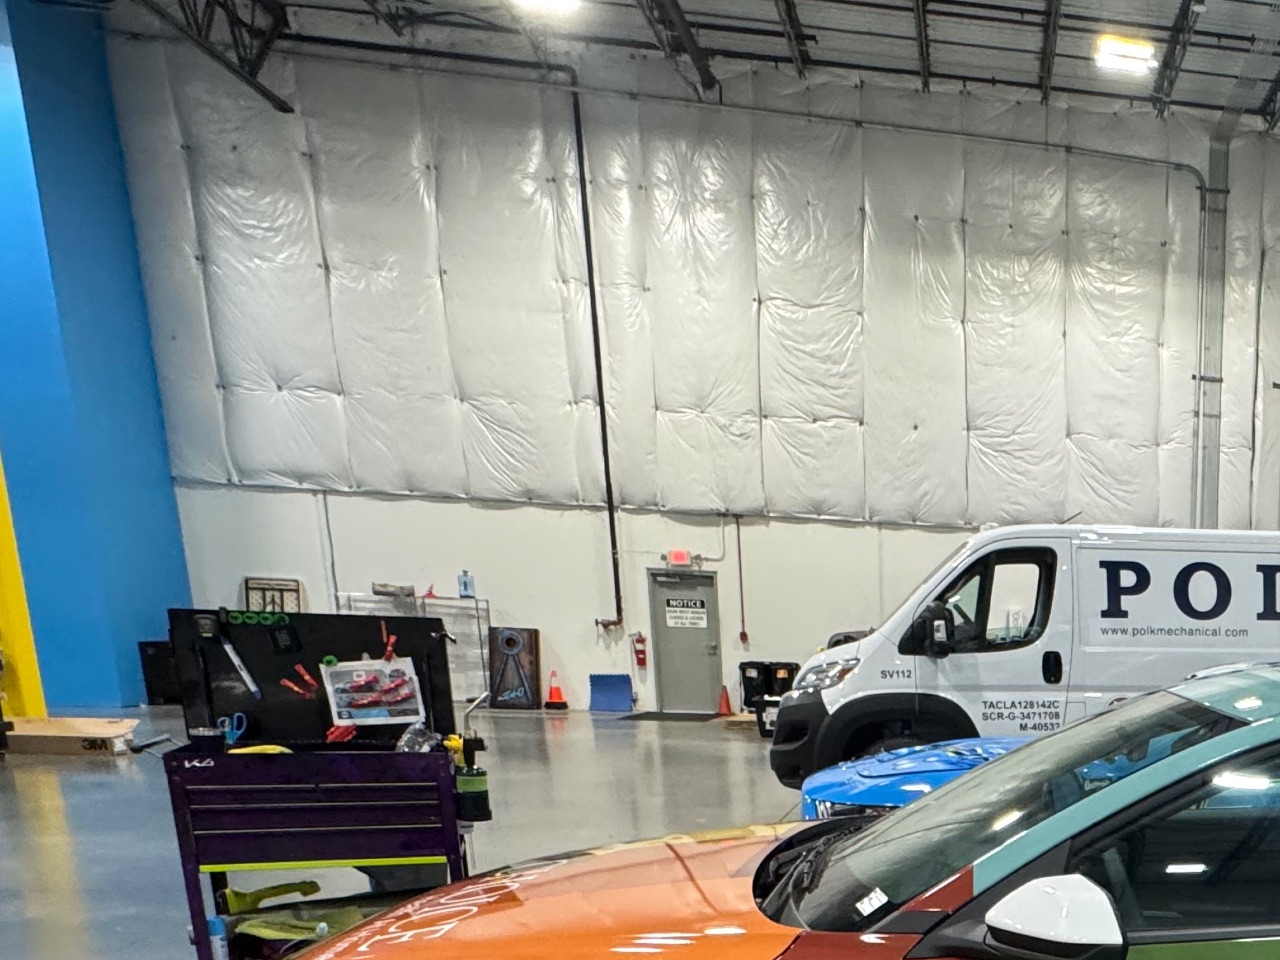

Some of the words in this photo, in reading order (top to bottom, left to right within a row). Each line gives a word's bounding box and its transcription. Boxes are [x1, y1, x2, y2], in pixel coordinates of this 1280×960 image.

[670, 600, 702, 608] NOTICE
[1100, 626, 1249, 638] www.polkmechanical.com
[880, 670, 912, 679] SV112
[982, 700, 1060, 710] TACLA128142C
[981, 711, 1061, 721] SCR-G-3471708
